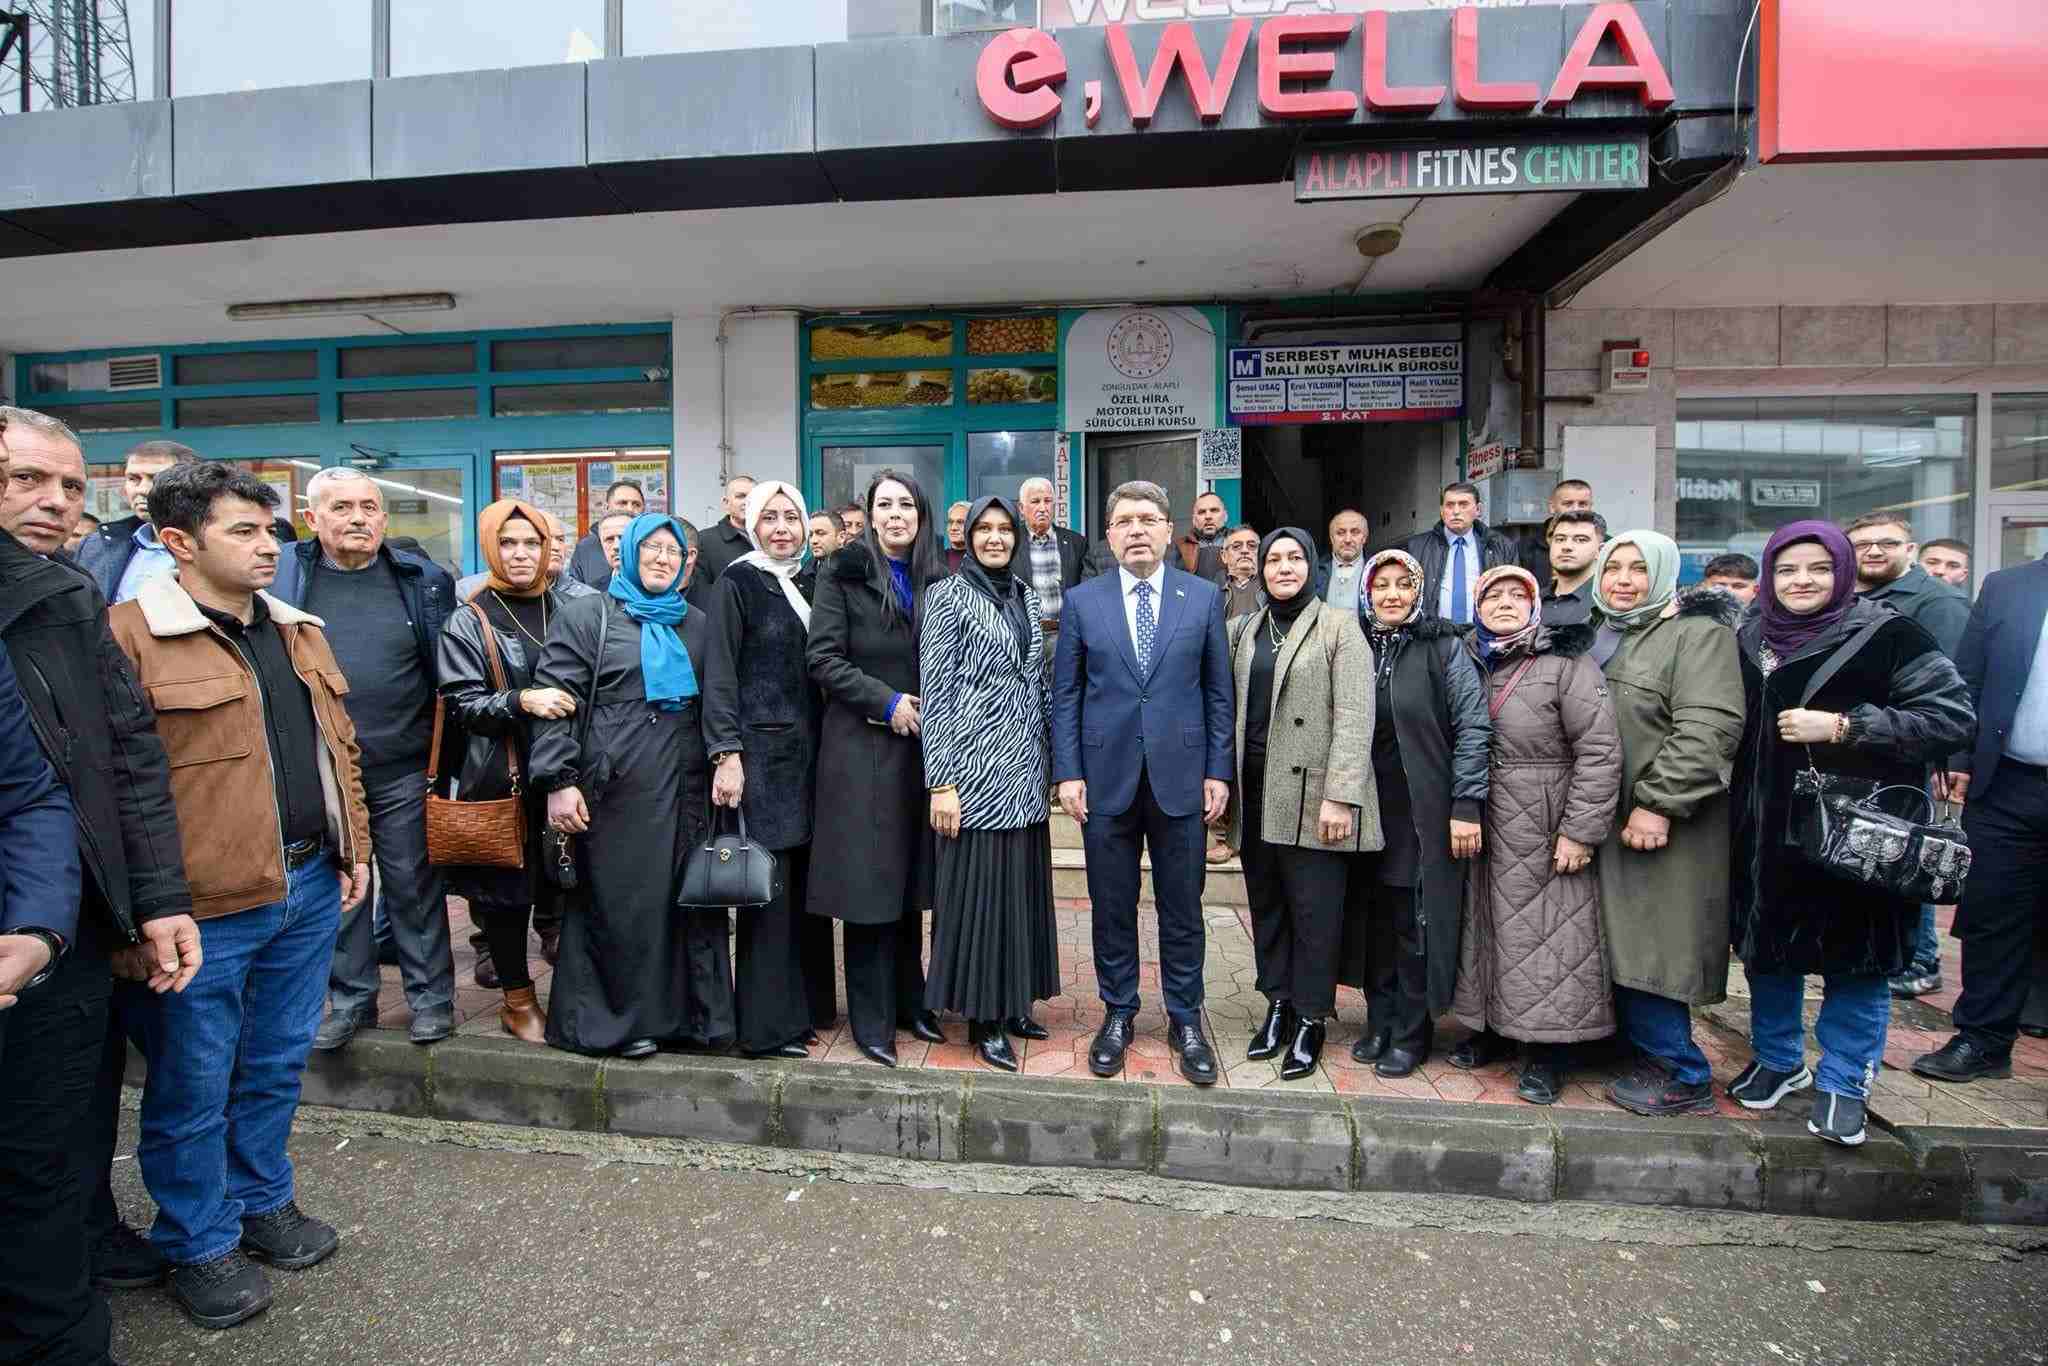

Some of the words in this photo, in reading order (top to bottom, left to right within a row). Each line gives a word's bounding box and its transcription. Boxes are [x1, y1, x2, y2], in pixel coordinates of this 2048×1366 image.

[1304, 151, 1409, 192] ALAPLI
[1523, 143, 1640, 183] CENTER
[1264, 350, 1341, 363] SERBEST
[1111, 393, 1139, 404] ÖZEL
[1096, 406, 1151, 416] MOTORLU
[1342, 411, 1370, 420] KAT
[1085, 416, 1155, 428] SÜRÜCÜLERİ
[1158, 416, 1196, 427] KURSU
